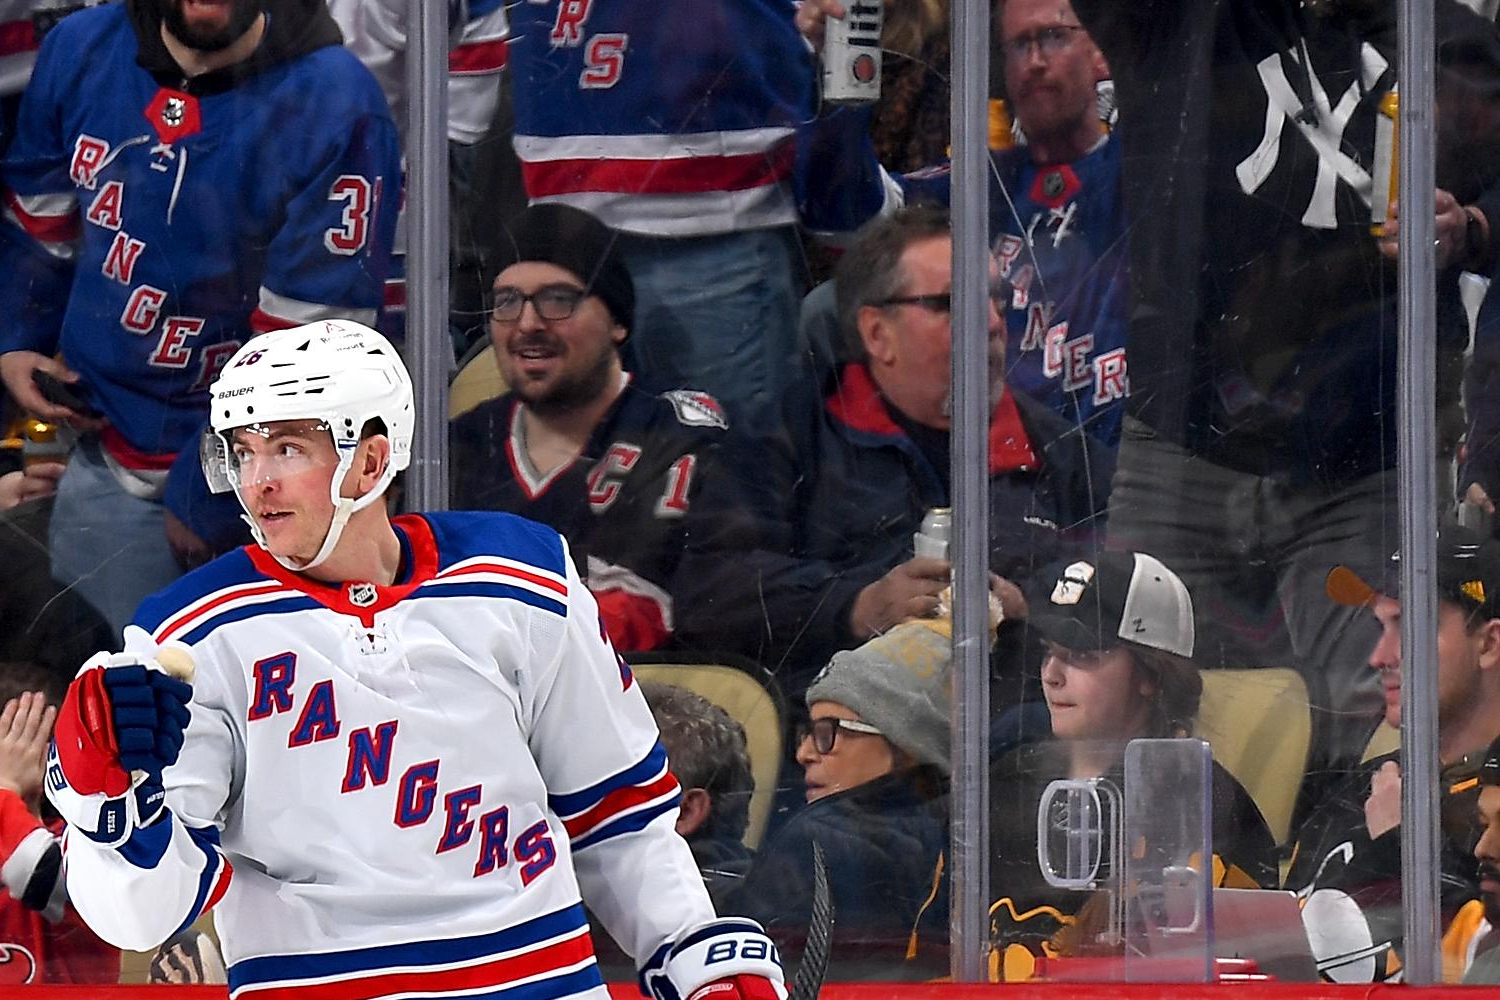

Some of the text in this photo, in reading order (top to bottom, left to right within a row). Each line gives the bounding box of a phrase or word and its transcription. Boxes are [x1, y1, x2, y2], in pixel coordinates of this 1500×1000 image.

[218, 386, 255, 400] BAUER
[586, 442, 643, 515] C
[247, 651, 557, 888] RANGERS
